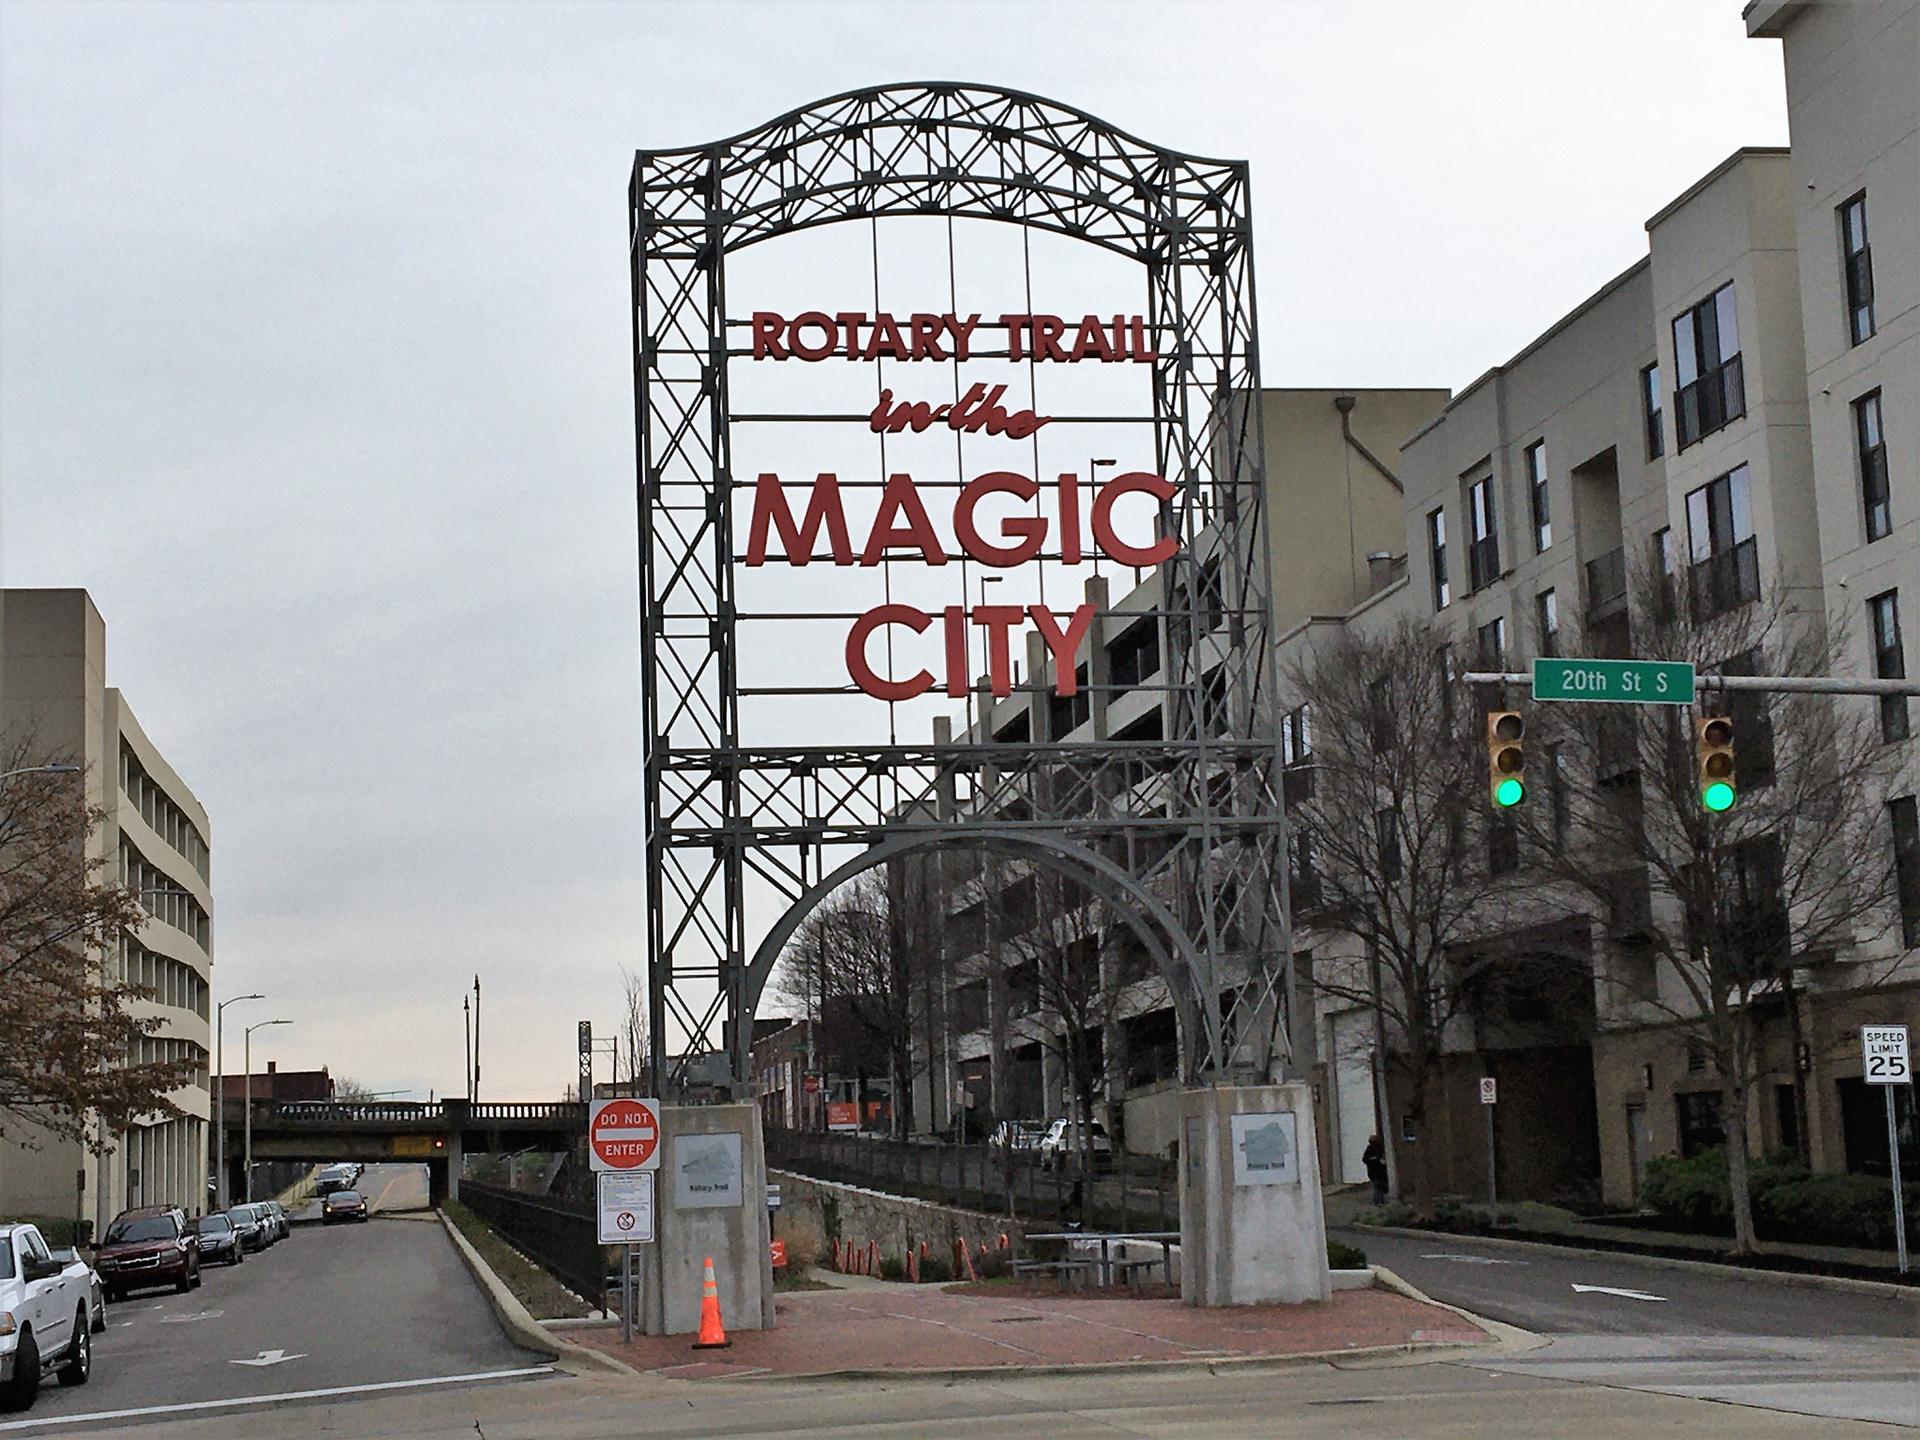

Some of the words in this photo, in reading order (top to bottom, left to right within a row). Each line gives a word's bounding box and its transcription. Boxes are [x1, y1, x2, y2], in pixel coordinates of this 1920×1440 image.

[752, 311, 982, 362] ROTARY
[999, 314, 1159, 363] TRAIL
[869, 388, 946, 434] in
[947, 382, 1053, 440] the
[745, 471, 1181, 568] MAGIC
[845, 603, 1097, 702] CITY
[1561, 669, 1607, 691] 20th
[1621, 670, 1642, 692] St
[1655, 671, 1669, 693] S
[1866, 1032, 1905, 1042] SPEED
[1871, 1044, 1901, 1054] LIMIT
[1869, 1056, 1906, 1077] 25
[601, 1113, 618, 1125] DO
[624, 1112, 649, 1124] NOT
[605, 1143, 644, 1156] ENTER
